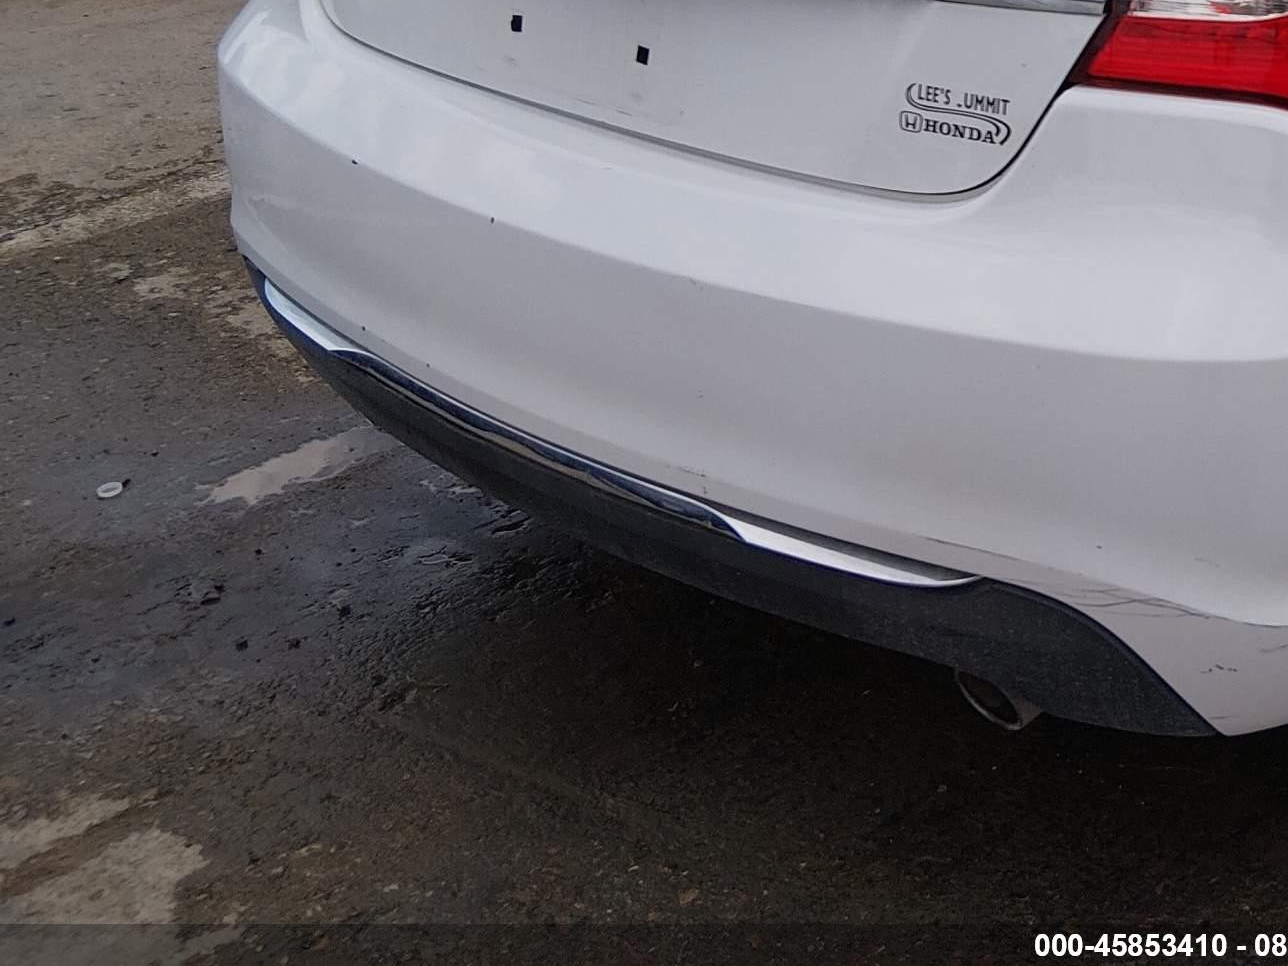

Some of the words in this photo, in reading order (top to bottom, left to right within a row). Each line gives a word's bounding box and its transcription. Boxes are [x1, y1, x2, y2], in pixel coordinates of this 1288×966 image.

[917, 83, 952, 106] LEE'S
[956, 91, 1011, 116] UMMIT
[923, 117, 997, 145] HONDA
